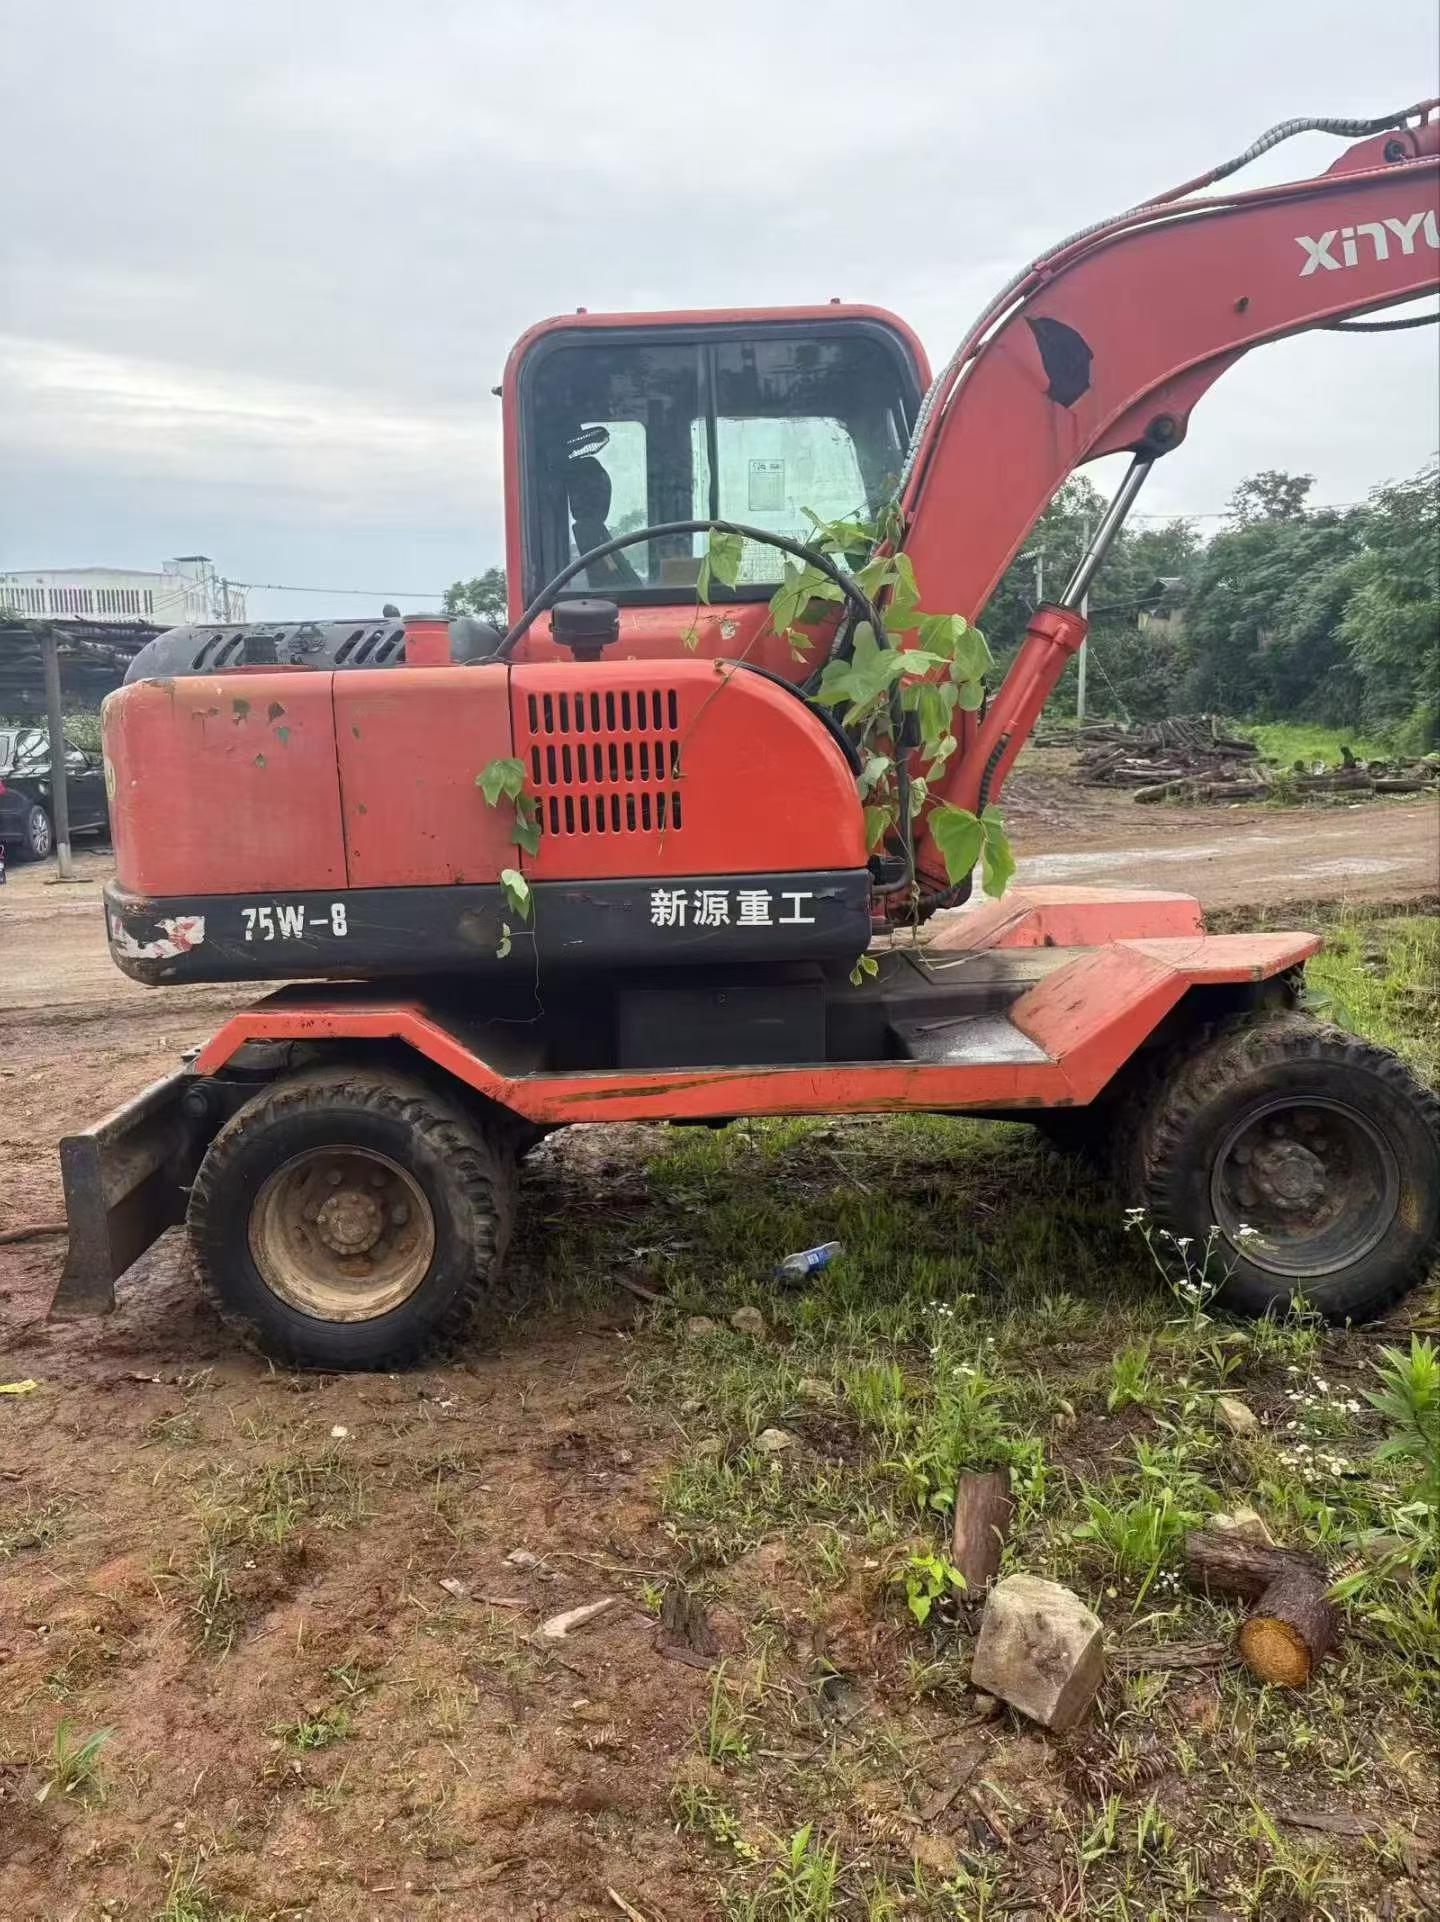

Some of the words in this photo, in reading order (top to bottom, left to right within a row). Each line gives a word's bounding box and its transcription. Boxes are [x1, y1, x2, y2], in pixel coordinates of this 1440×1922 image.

[241, 903, 348, 941] 75W-8
[650, 888, 816, 927] 新源重工
